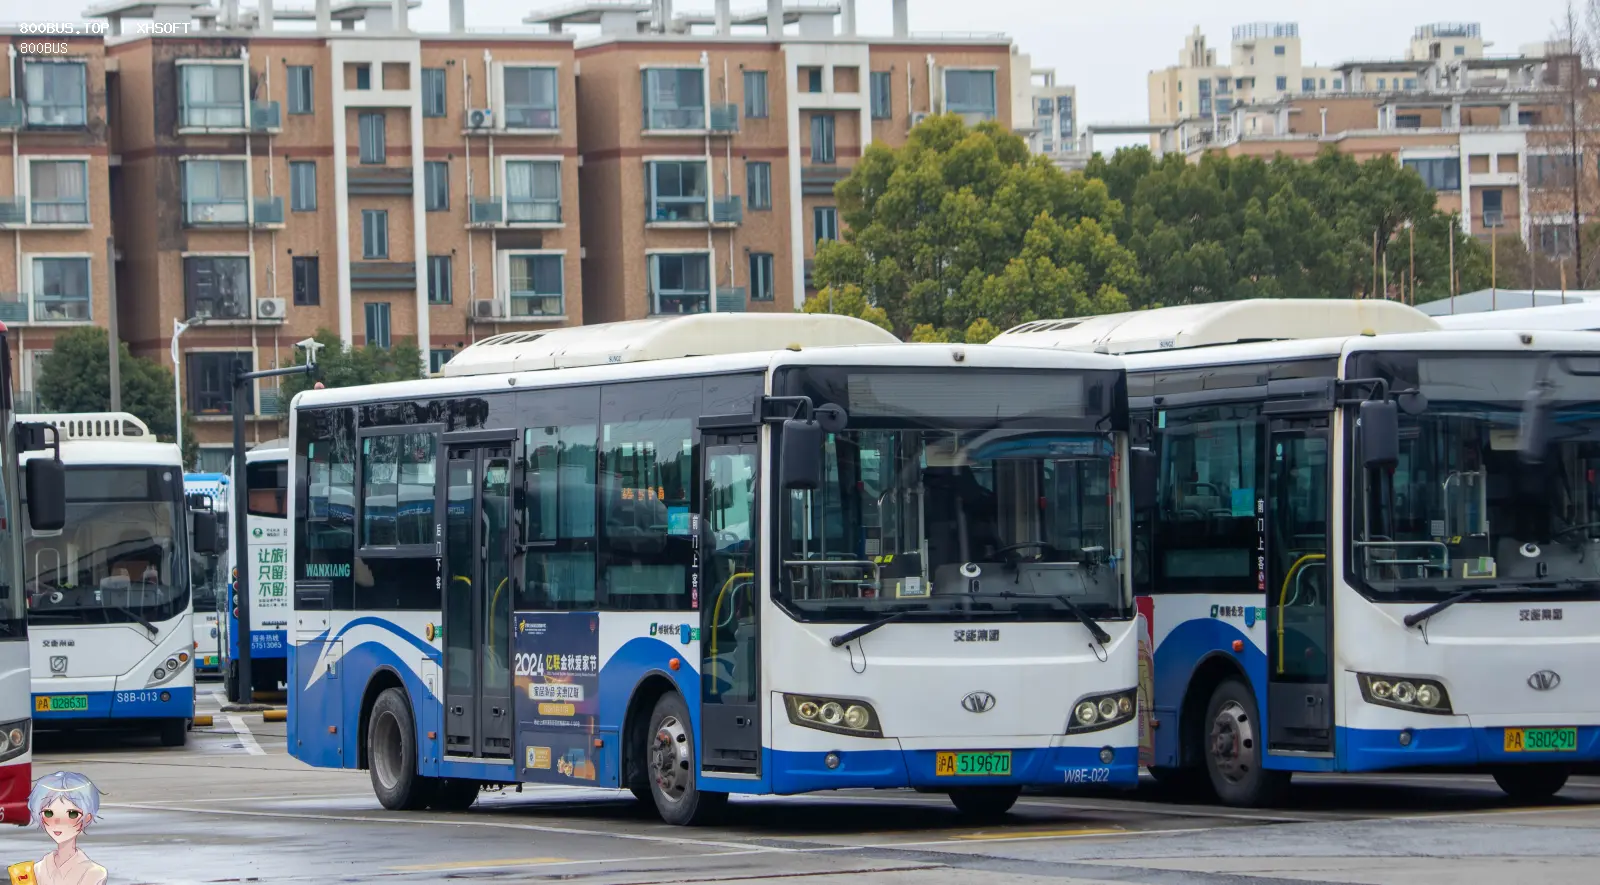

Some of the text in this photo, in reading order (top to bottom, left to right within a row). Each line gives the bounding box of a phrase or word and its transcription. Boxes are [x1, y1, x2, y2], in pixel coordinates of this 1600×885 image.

[306, 563, 351, 577] WANXIANG
[515, 653, 597, 676] 2024 亿联金秋爱家节
[117, 691, 157, 703] S8B-013
[1528, 730, 1575, 749] 58029D
[937, 754, 1010, 773] 沪A 51967D
[1064, 768, 1110, 783] W8E-022
